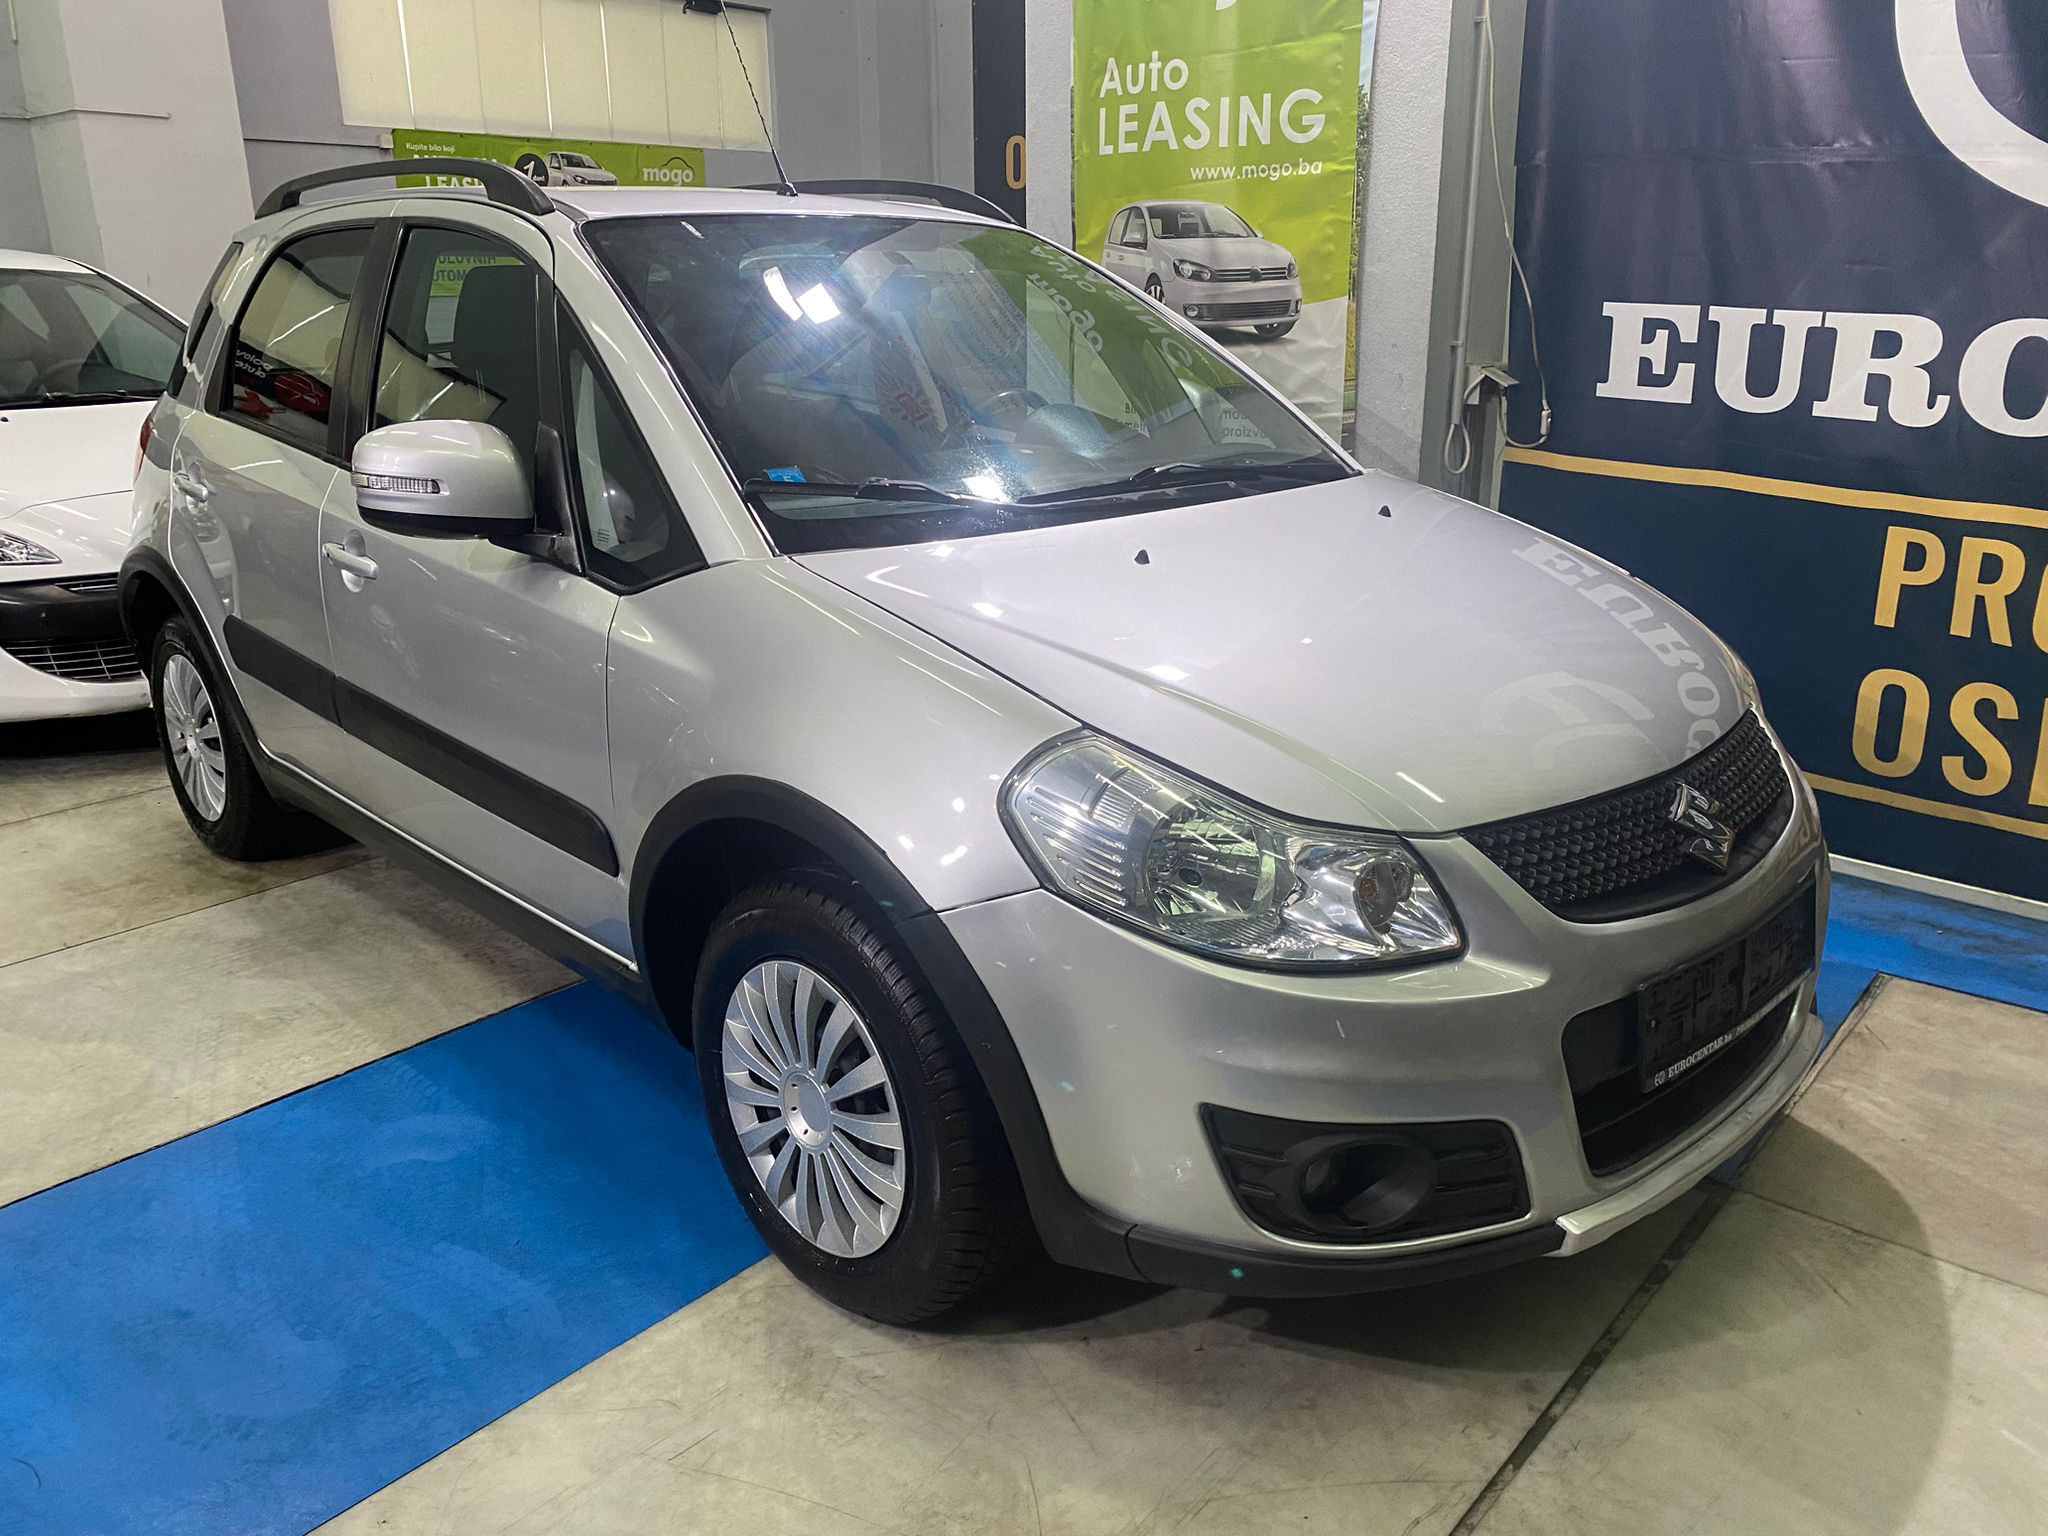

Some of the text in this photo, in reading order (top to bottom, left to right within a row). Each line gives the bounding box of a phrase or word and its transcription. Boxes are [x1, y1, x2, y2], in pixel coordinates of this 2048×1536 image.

[1099, 51, 1189, 98] Auto
[1099, 88, 1326, 156] LEASING
[405, 143, 428, 152] Kupite
[1190, 158, 1323, 182] www.mogo.ba
[643, 167, 693, 187] mogo
[1595, 301, 2048, 438] EURO
[1874, 526, 2048, 654] PR
[1667, 1036, 1723, 1079] EUROCENTAR
